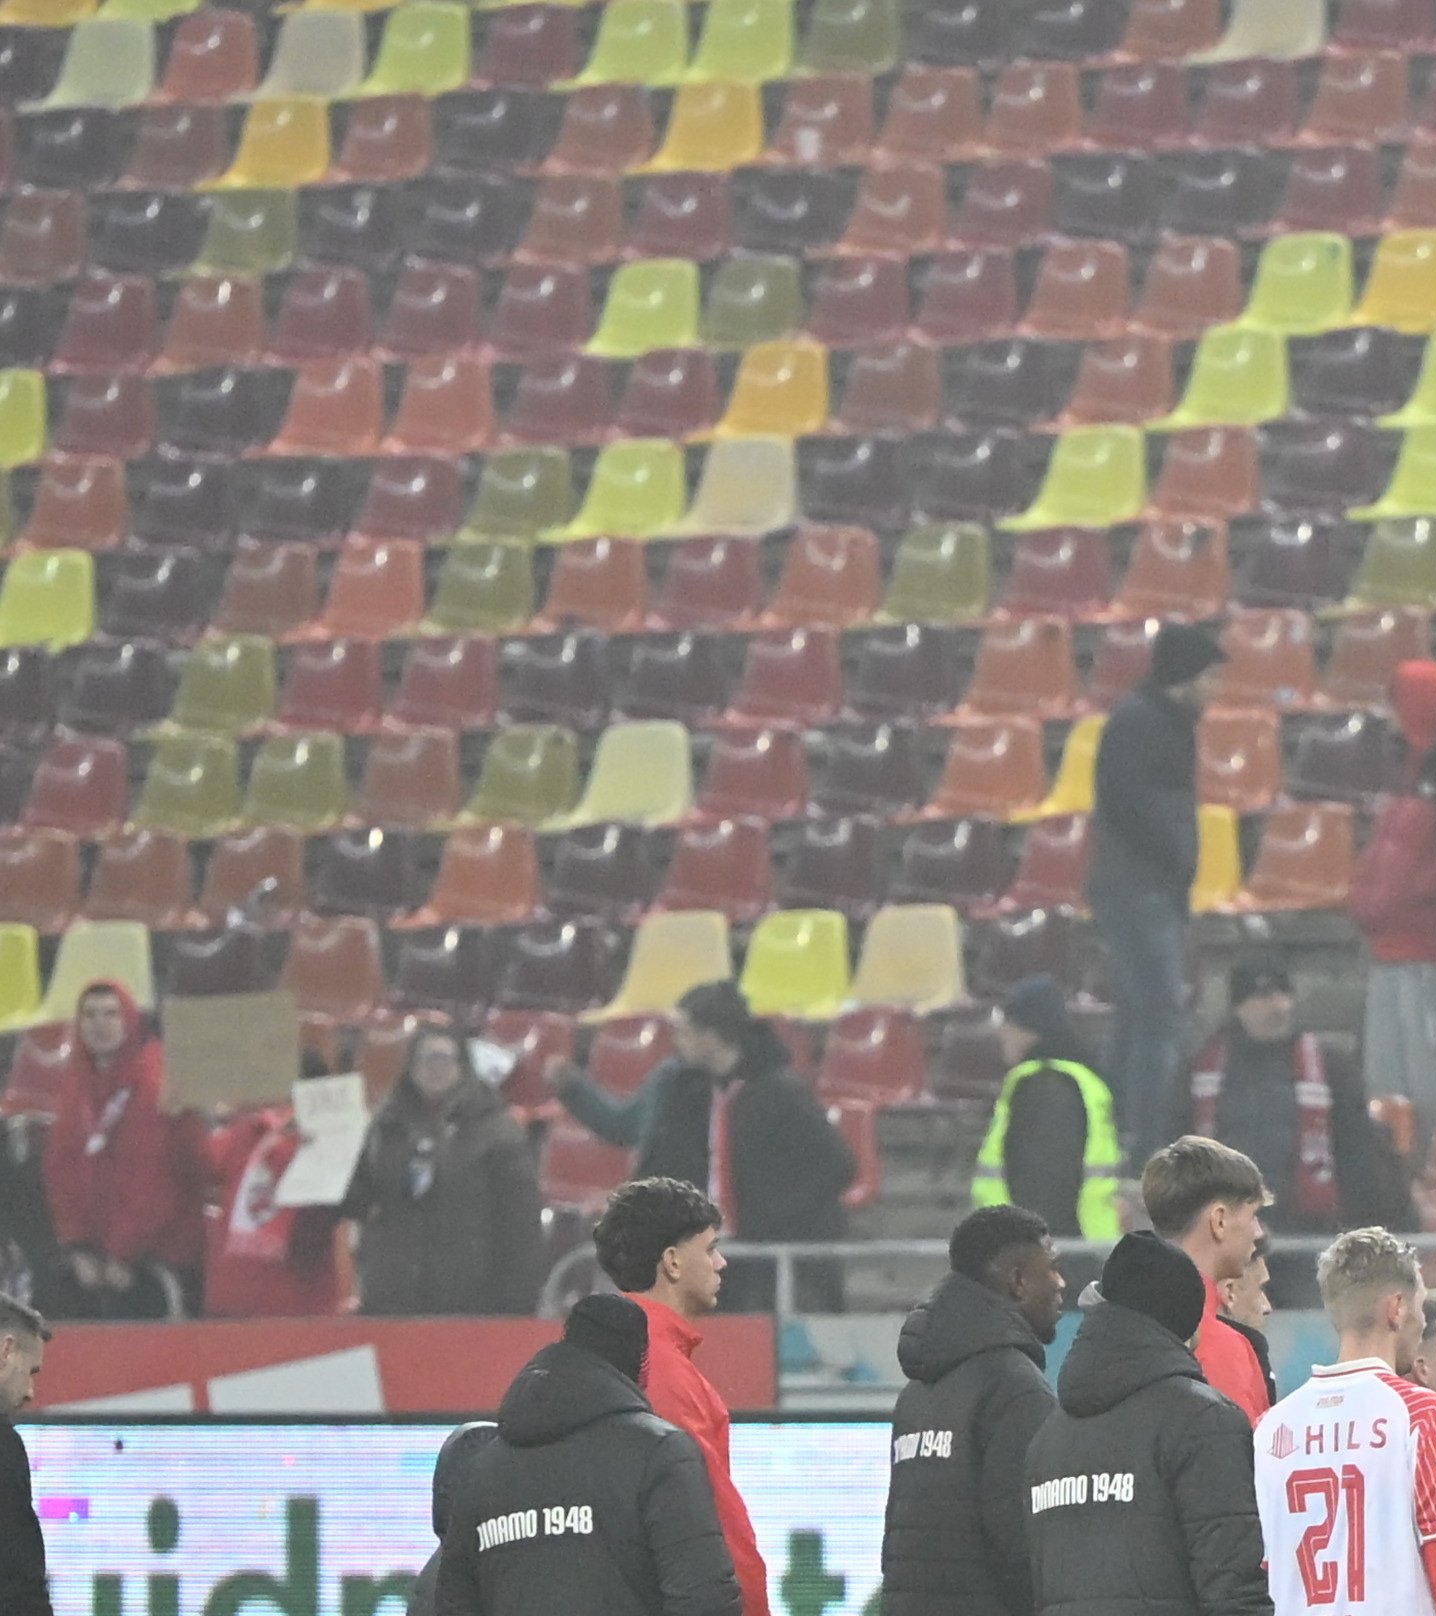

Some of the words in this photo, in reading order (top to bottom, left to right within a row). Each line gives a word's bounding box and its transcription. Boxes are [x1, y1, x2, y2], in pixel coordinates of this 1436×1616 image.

[919, 1429, 953, 1459] 1948
[1304, 1417, 1389, 1456] HILS
[1030, 1474, 1088, 1515] DINAMO
[1091, 1472, 1135, 1503] 1948
[542, 1505, 594, 1536] 1948
[1285, 1463, 1366, 1608] 21
